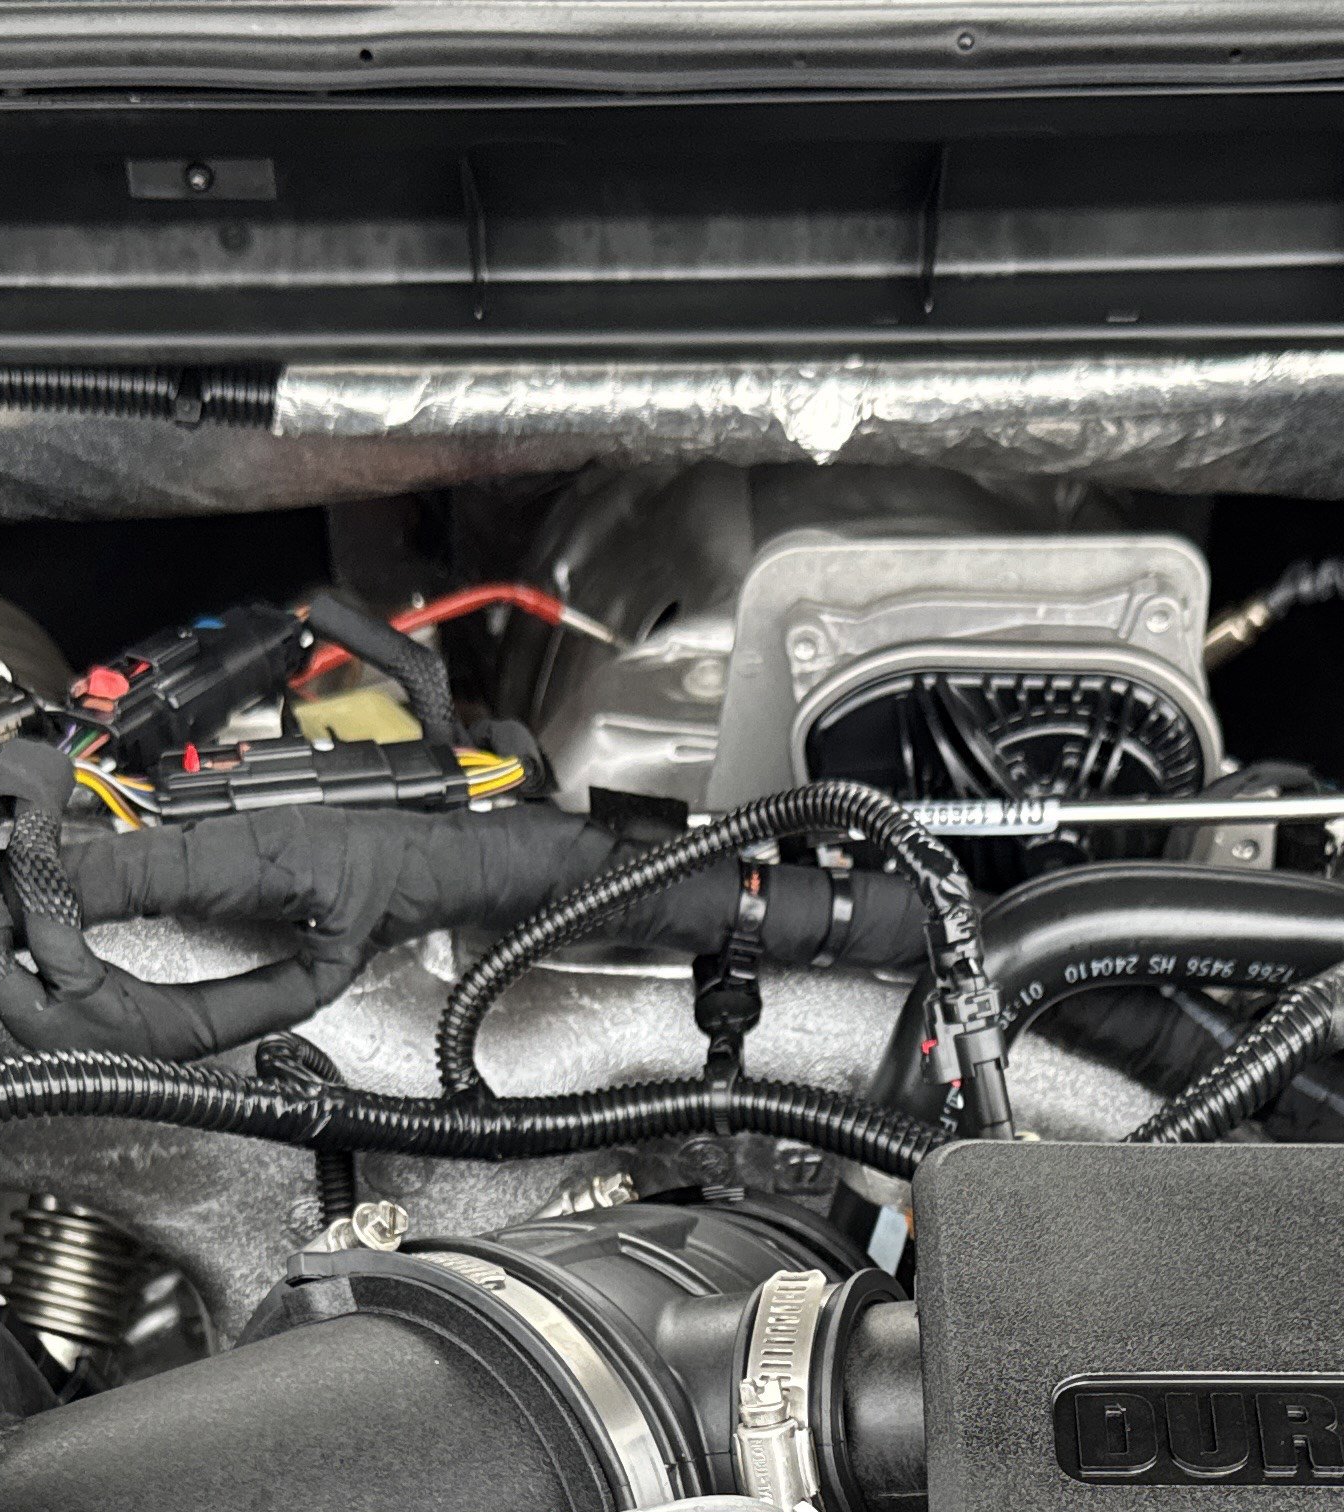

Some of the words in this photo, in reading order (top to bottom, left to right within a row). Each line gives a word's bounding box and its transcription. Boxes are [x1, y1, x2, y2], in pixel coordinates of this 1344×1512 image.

[1064, 953, 1140, 984] 240410
[1148, 954, 1178, 974] HS
[1186, 956, 1236, 978] 9456
